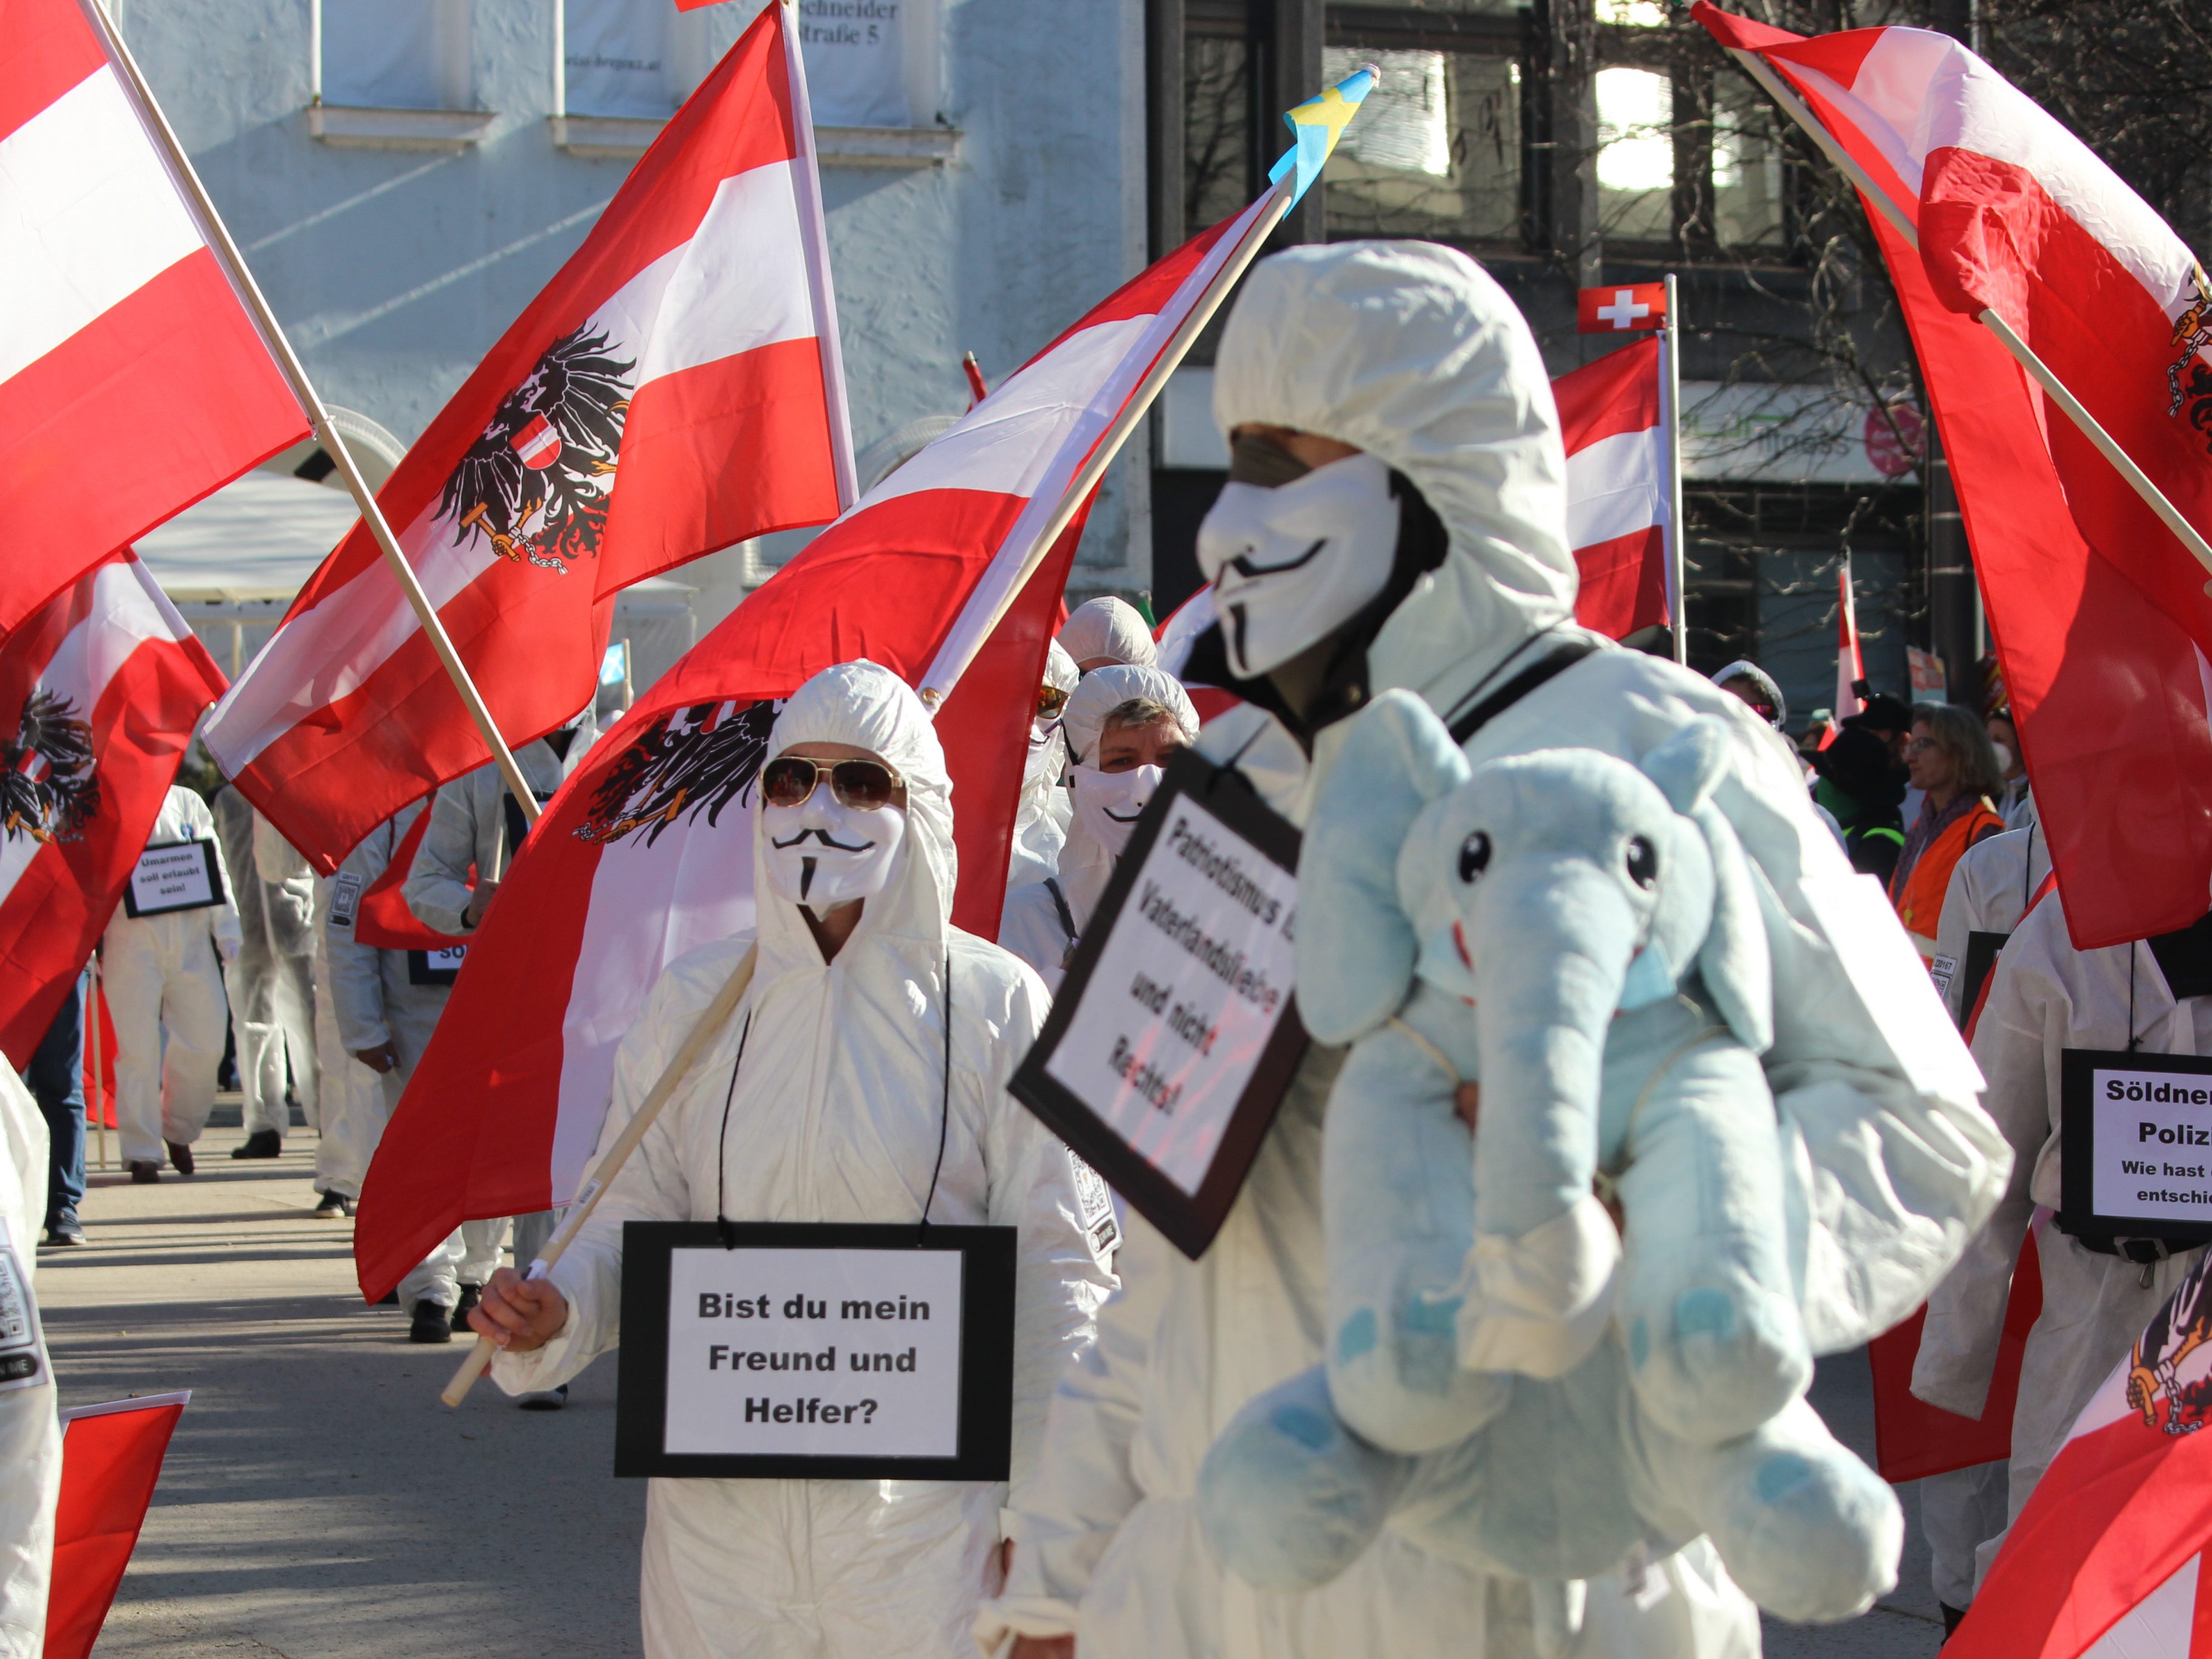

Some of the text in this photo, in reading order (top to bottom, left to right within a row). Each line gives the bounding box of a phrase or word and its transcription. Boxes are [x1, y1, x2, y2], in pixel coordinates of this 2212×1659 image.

[867, 24, 880, 45] 5
[141, 853, 193, 867] Umarmen
[1166, 817, 1281, 926] Patriotismus
[140, 867, 200, 883] soll erlaubt
[160, 883, 186, 894] sein!
[1139, 880, 1279, 1015] Vaterlandsliebe
[1130, 970, 1220, 1058] und nicht
[1108, 1032, 1183, 1118] Rechts!
[2106, 1079, 2212, 1106] Söldne
[2138, 1121, 2212, 1146] Poliz
[2121, 1160, 2157, 1176] Wie
[2163, 1162, 2205, 1178] hast
[699, 1292, 931, 1320] Bist du mein
[710, 1344, 917, 1372] Freund und
[744, 1397, 879, 1424] Helfer?
